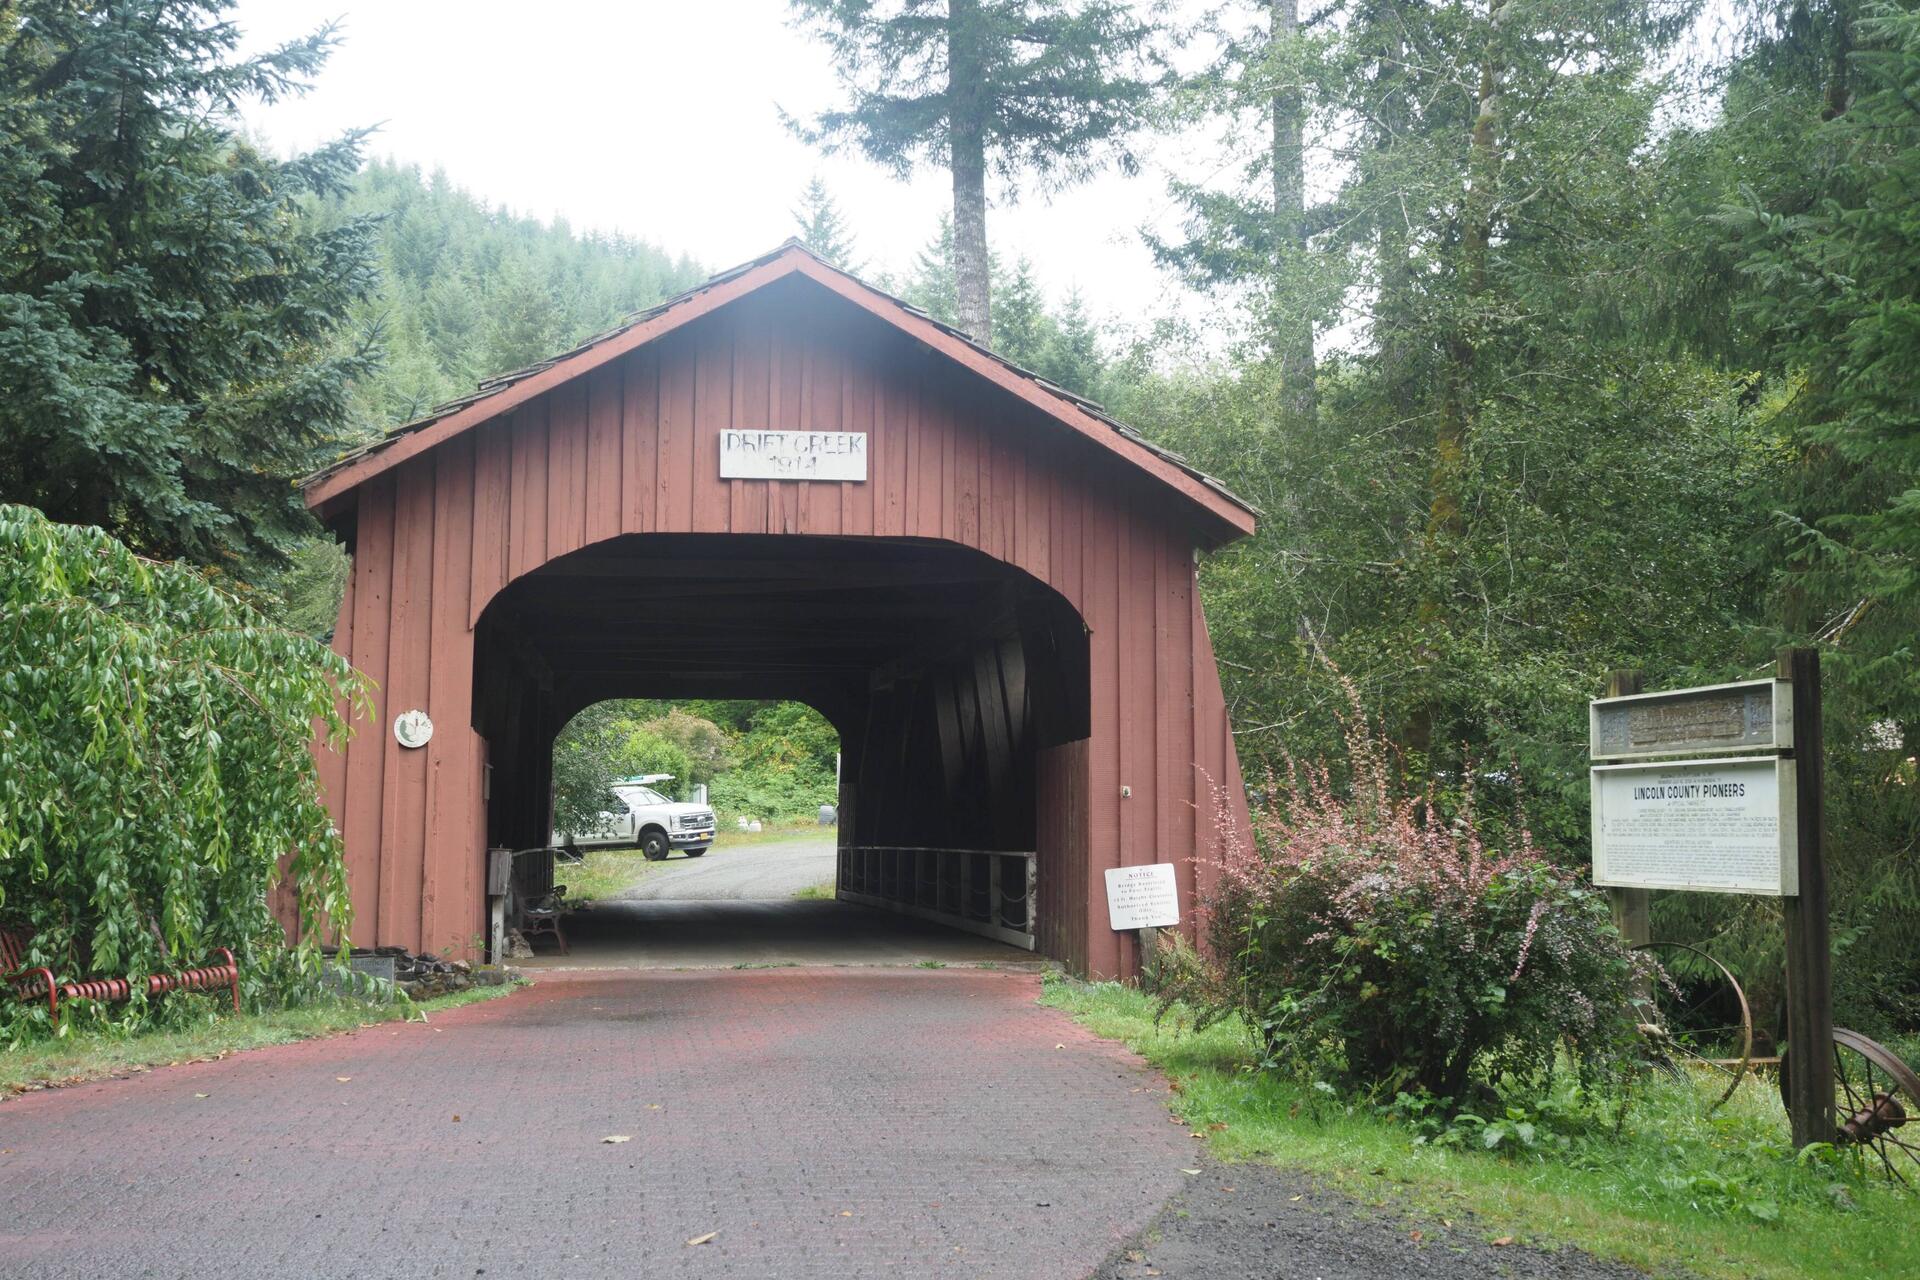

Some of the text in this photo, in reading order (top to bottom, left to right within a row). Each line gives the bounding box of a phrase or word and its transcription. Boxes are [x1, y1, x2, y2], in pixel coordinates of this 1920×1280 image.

[726, 432, 865, 455] DRIFT CREEK
[1634, 783, 1746, 801] LINCOLN COUNTY PIONEERS
